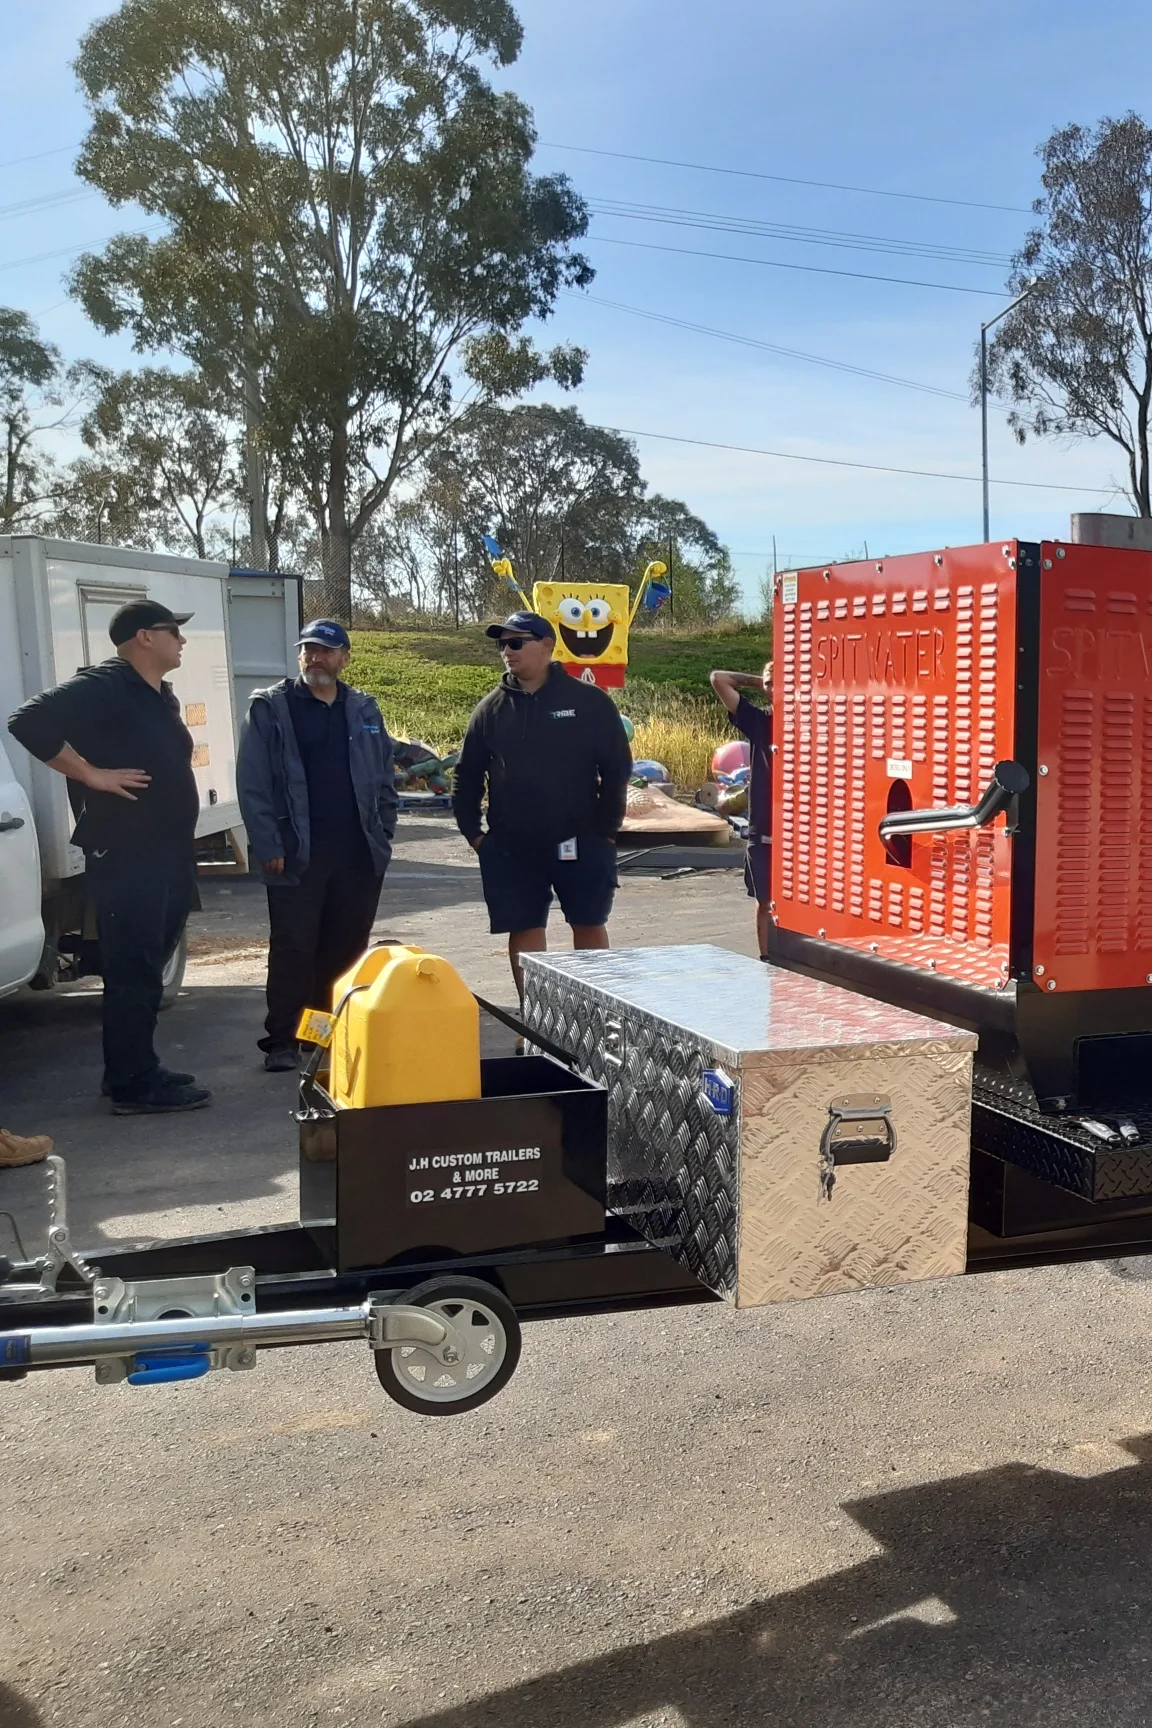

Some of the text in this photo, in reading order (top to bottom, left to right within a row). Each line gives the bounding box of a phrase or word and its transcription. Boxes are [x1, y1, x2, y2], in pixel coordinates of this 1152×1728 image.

[816, 628, 945, 682] SPITWATER
[409, 1147, 541, 1171] J.H CUSTOM TRAILERS
[452, 1168, 500, 1183] & MORE
[410, 1179, 539, 1203] 02 4777 5722
